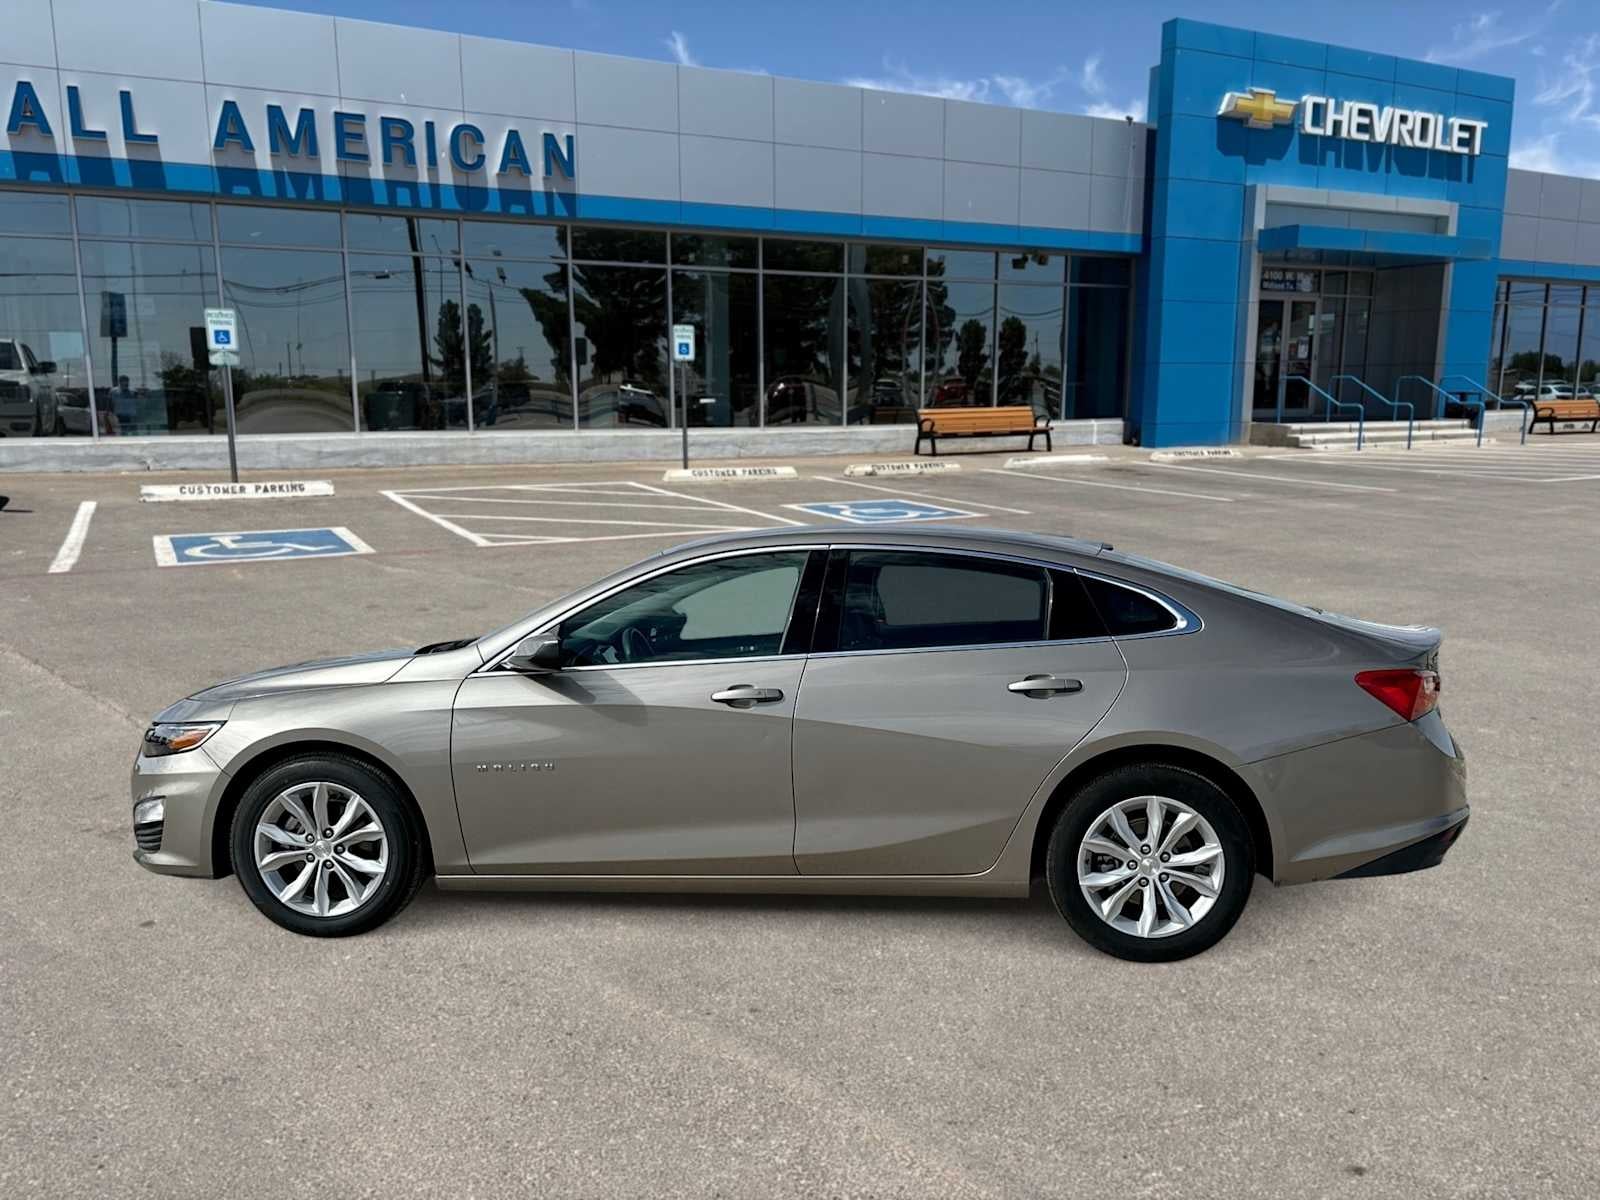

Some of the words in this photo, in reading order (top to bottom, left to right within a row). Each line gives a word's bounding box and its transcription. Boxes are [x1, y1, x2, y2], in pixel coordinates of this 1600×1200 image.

[6, 80, 158, 144] ALL
[213, 99, 575, 179] AMERICAN
[1302, 94, 1488, 155] CHEVROLET
[691, 469, 737, 477] CUSTOMER
[742, 468, 778, 476] PARKING
[871, 463, 910, 471] CUSTOMER
[914, 462, 945, 470] PARKING
[179, 485, 246, 495] CUSTOMER
[254, 483, 306, 494] PARKING
